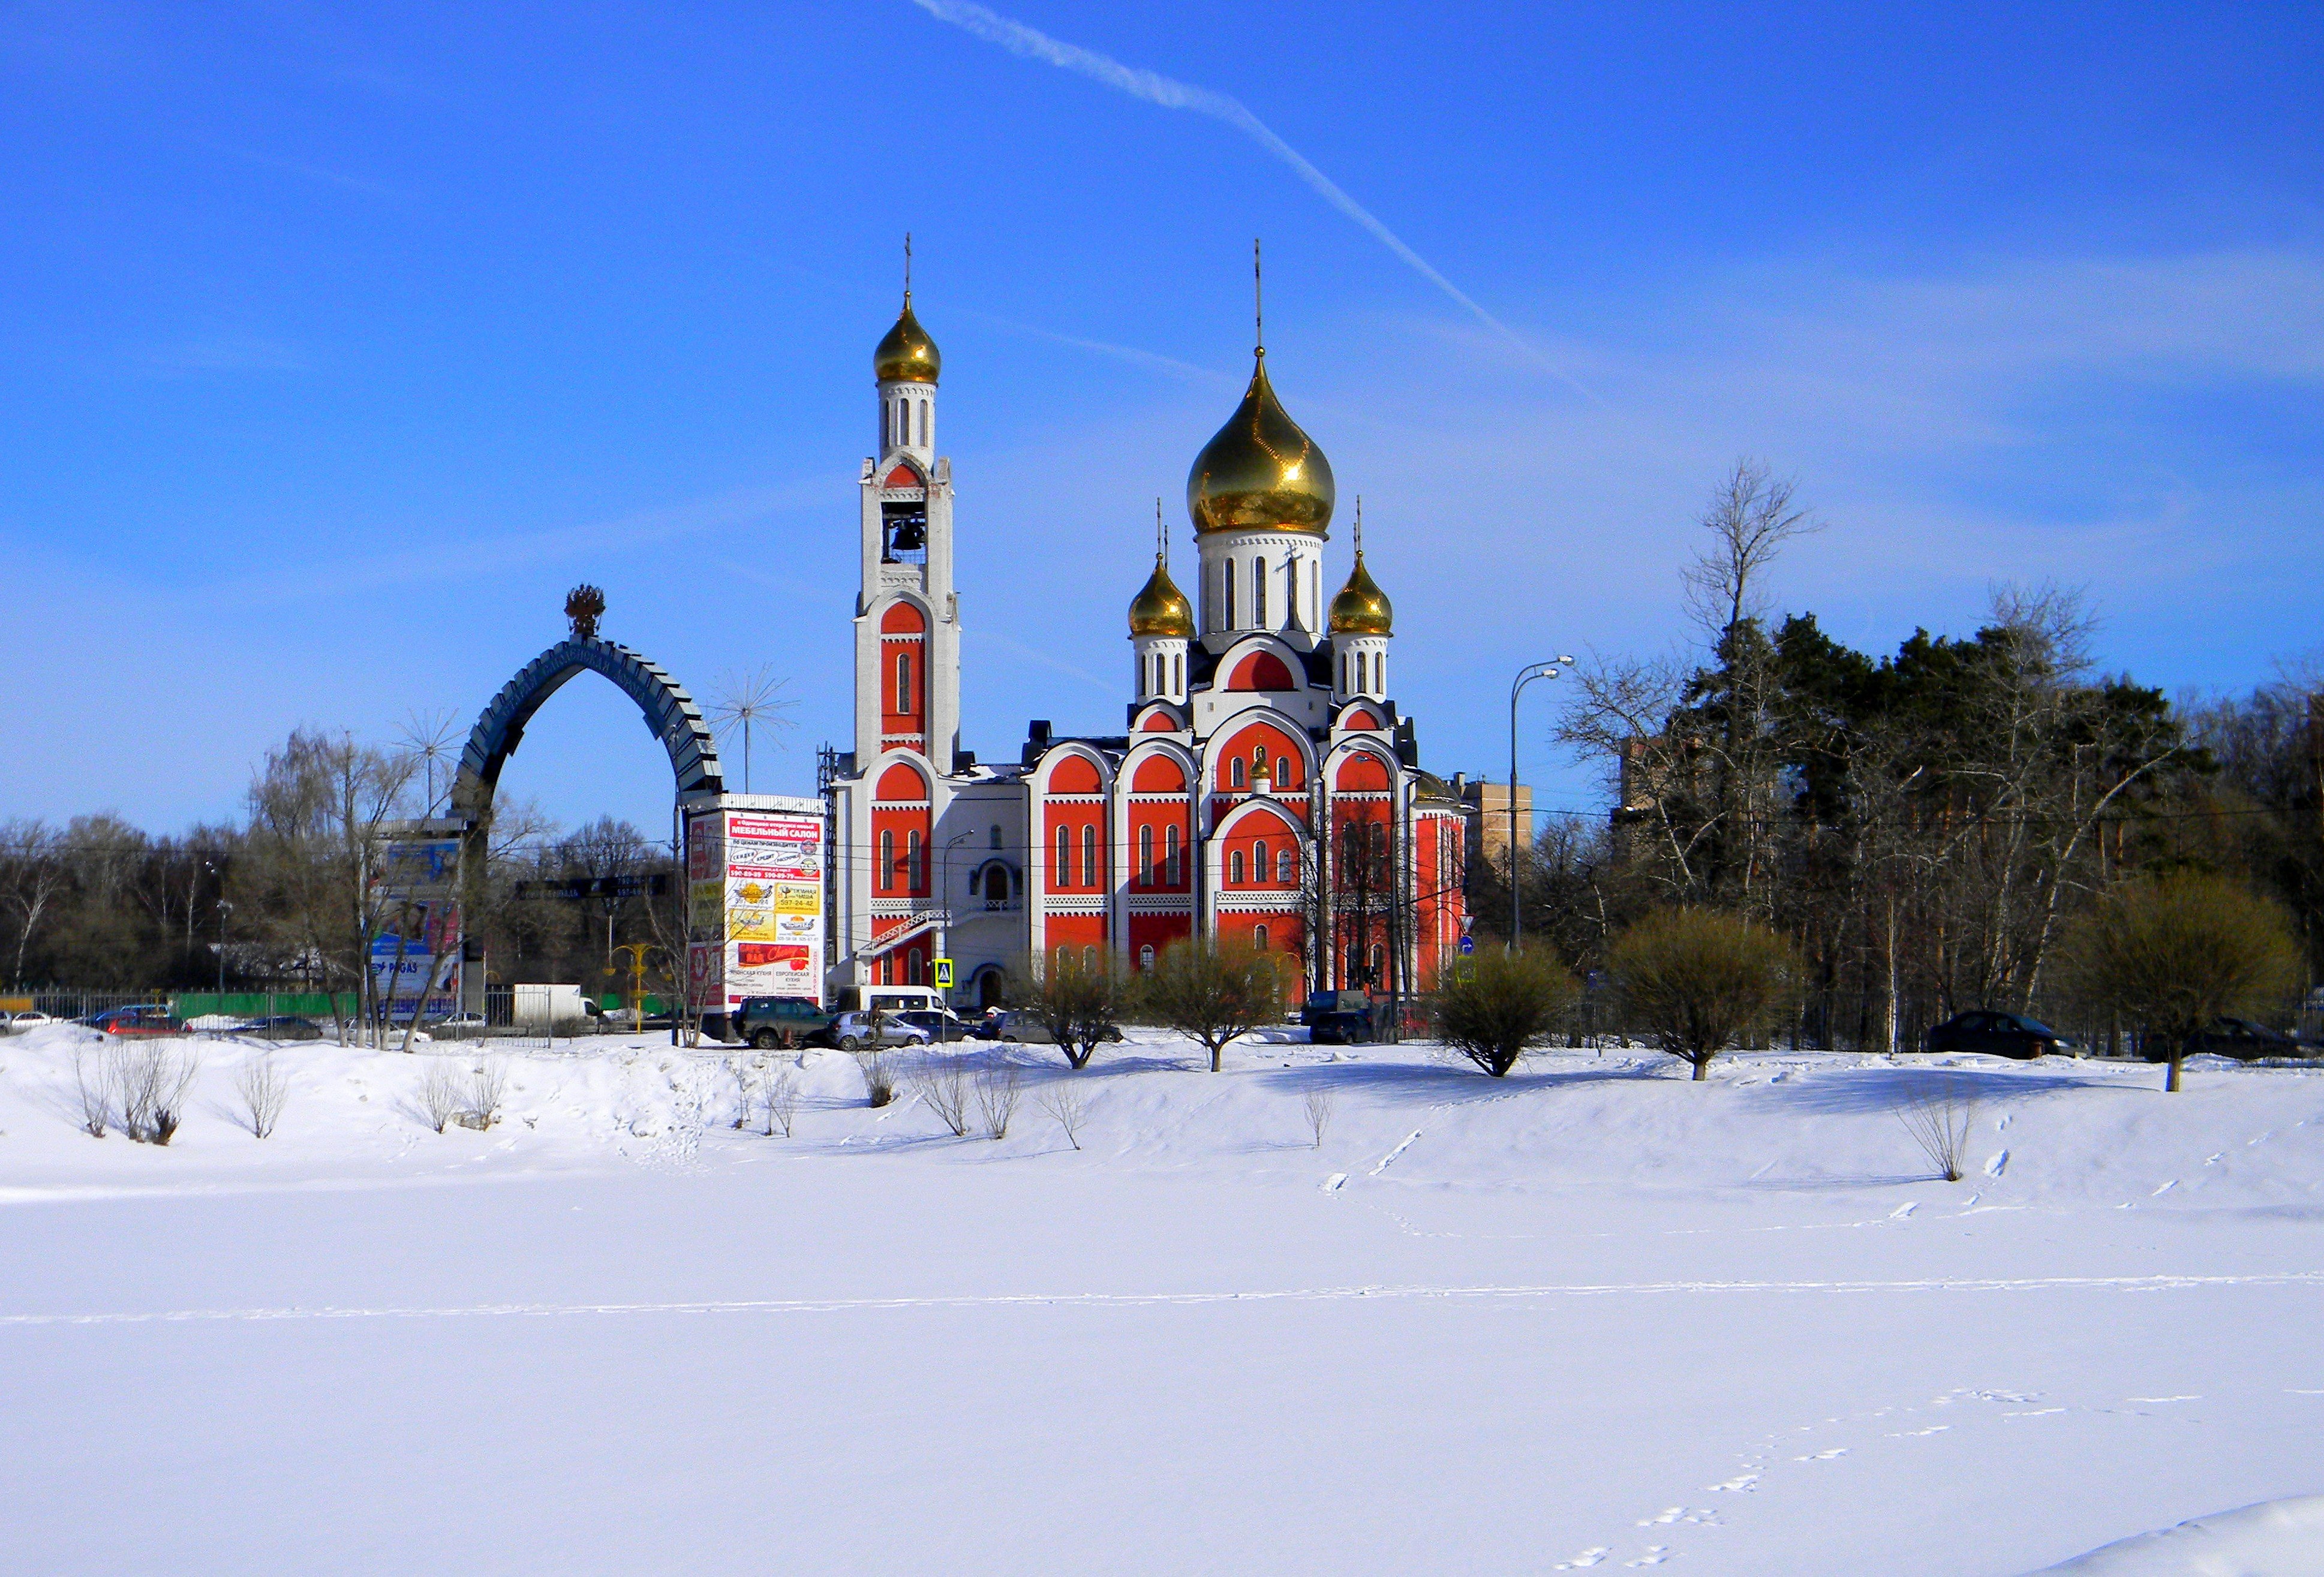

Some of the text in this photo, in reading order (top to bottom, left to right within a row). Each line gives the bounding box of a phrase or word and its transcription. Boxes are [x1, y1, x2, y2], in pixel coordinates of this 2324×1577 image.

[731, 826, 817, 838] МЕБЕЛЬНЫЙ САЛОН
[733, 851, 755, 860] СКИДКИ
[757, 853, 774, 862] КРЕДИТ
[389, 962, 418, 973] PGAS
